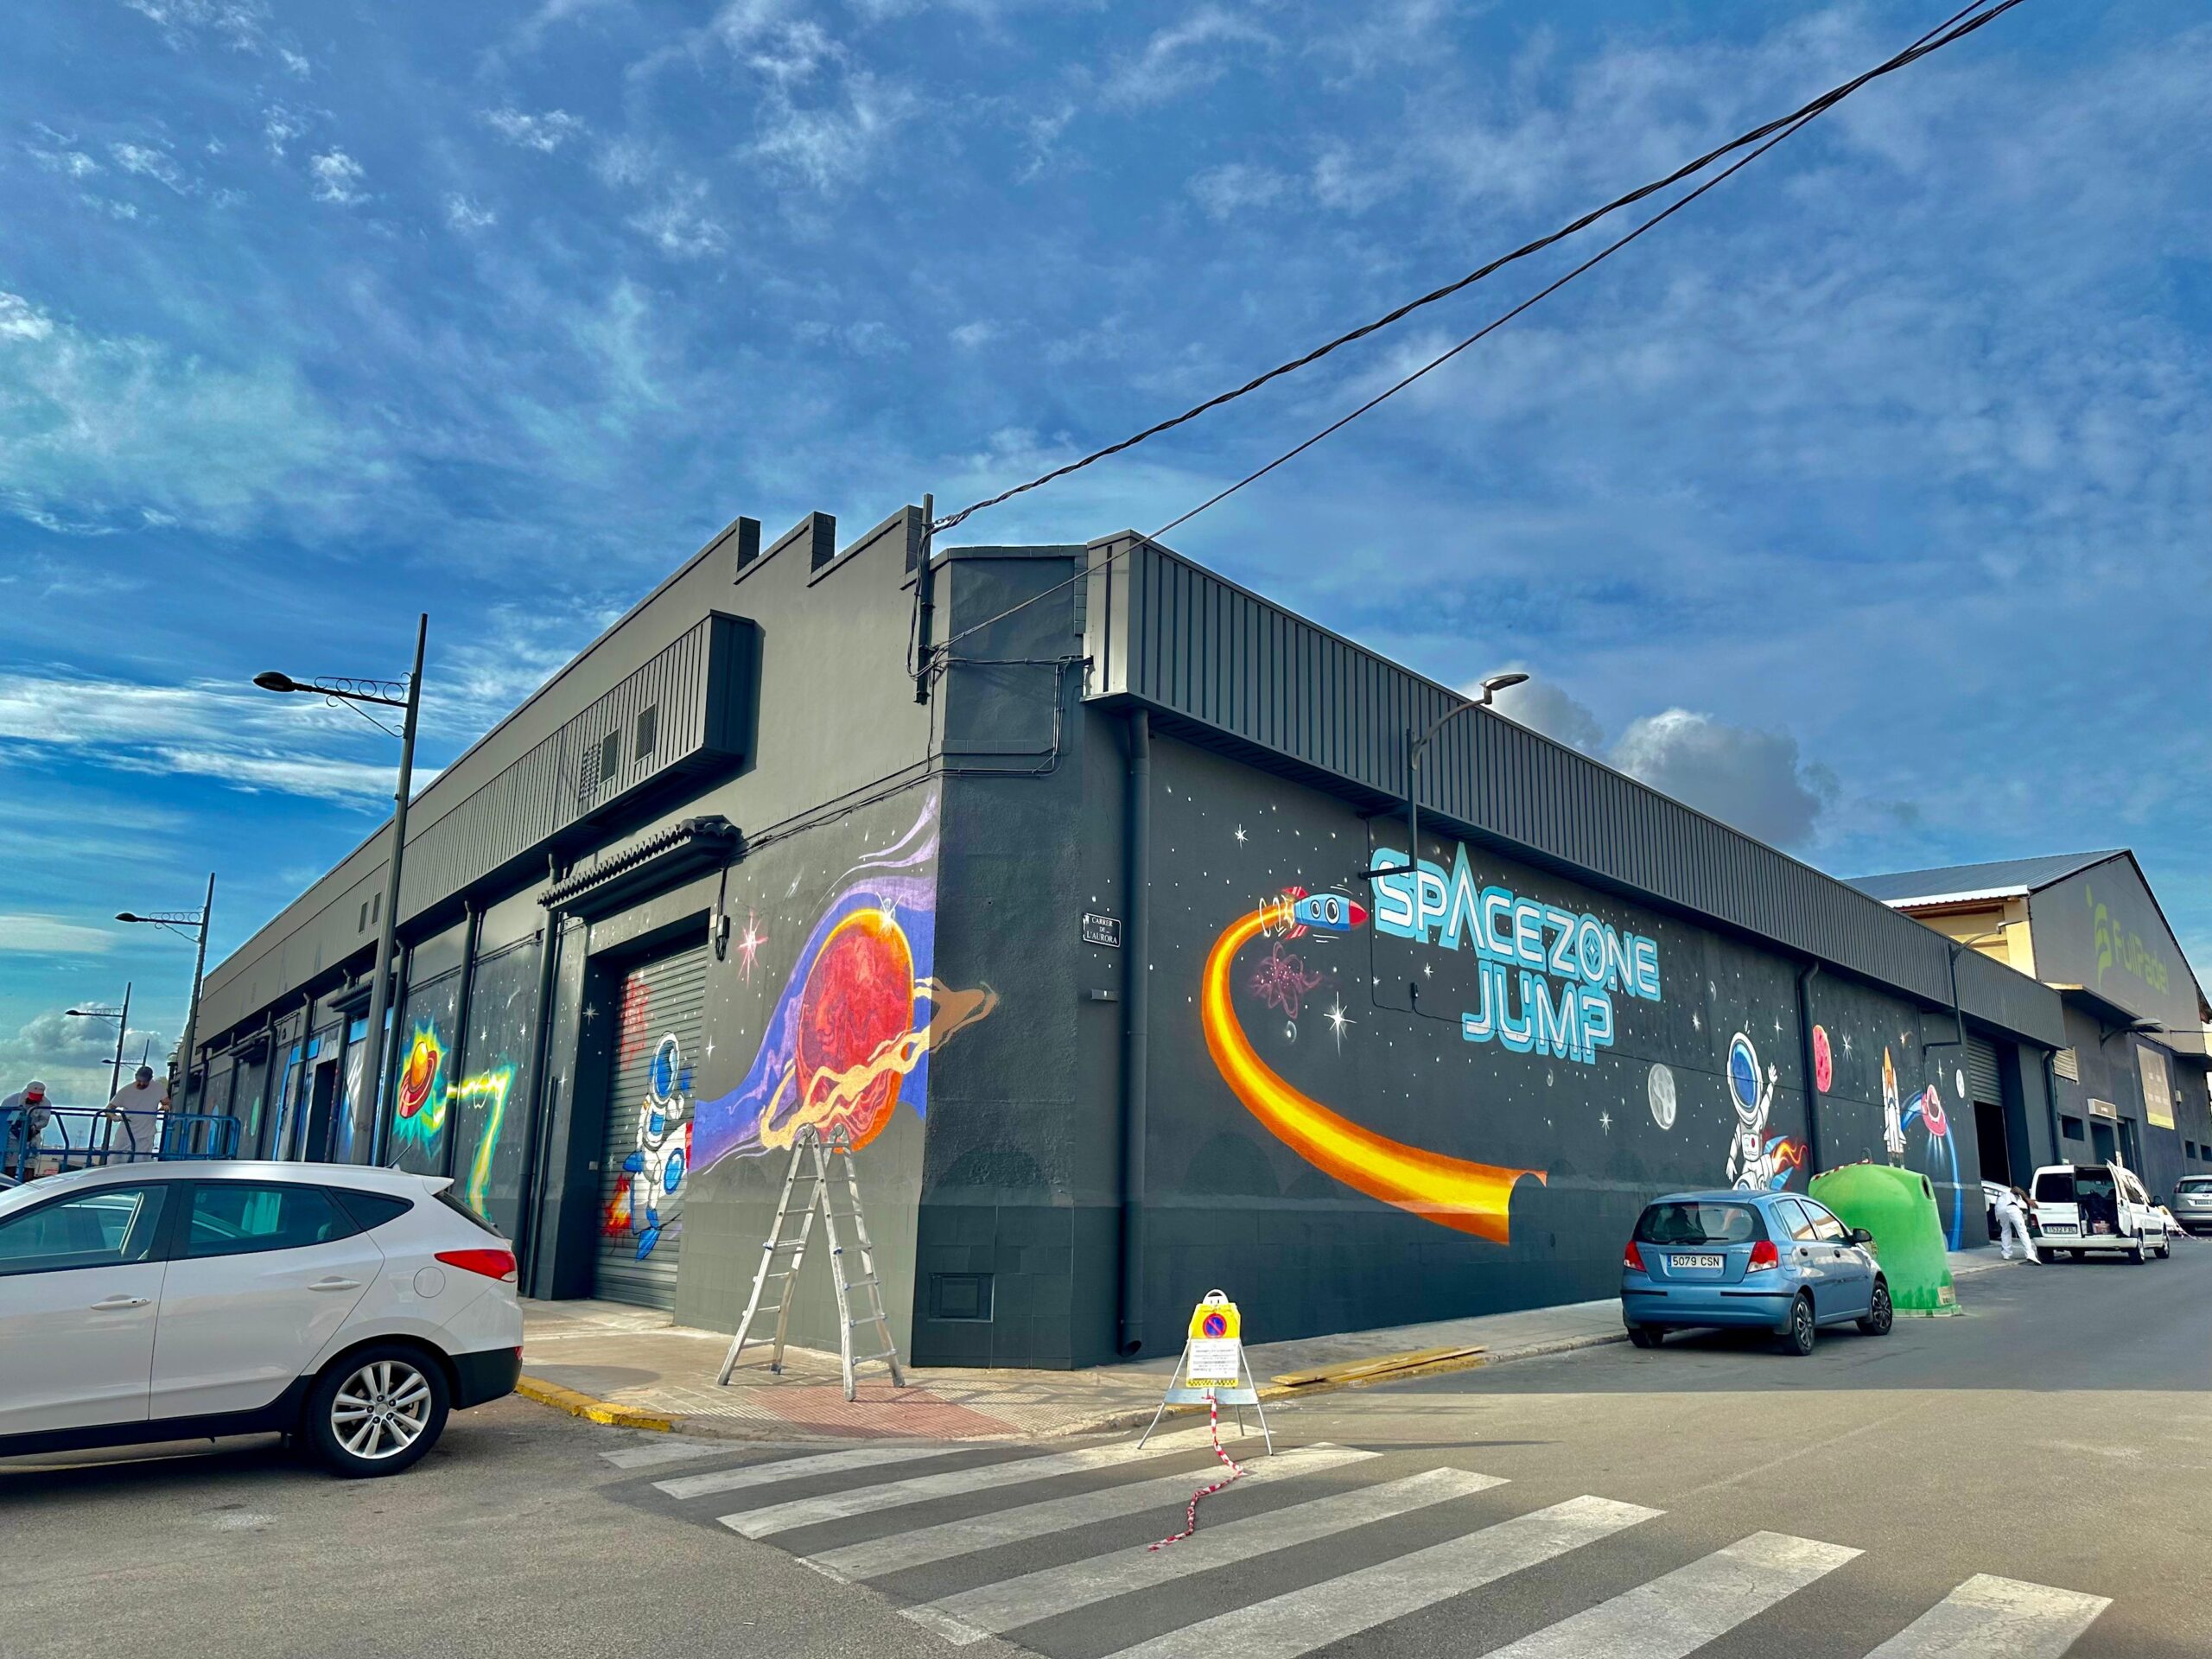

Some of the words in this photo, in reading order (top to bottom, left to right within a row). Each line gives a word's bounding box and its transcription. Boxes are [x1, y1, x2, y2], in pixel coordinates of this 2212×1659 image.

[1091, 917, 1113, 926] CARRER
[1086, 931, 1117, 944] L'AURORA
[1462, 960, 1614, 1065] JUMP
[1673, 1256, 1697, 1266] 5079
[1700, 1256, 1719, 1266] CSN
